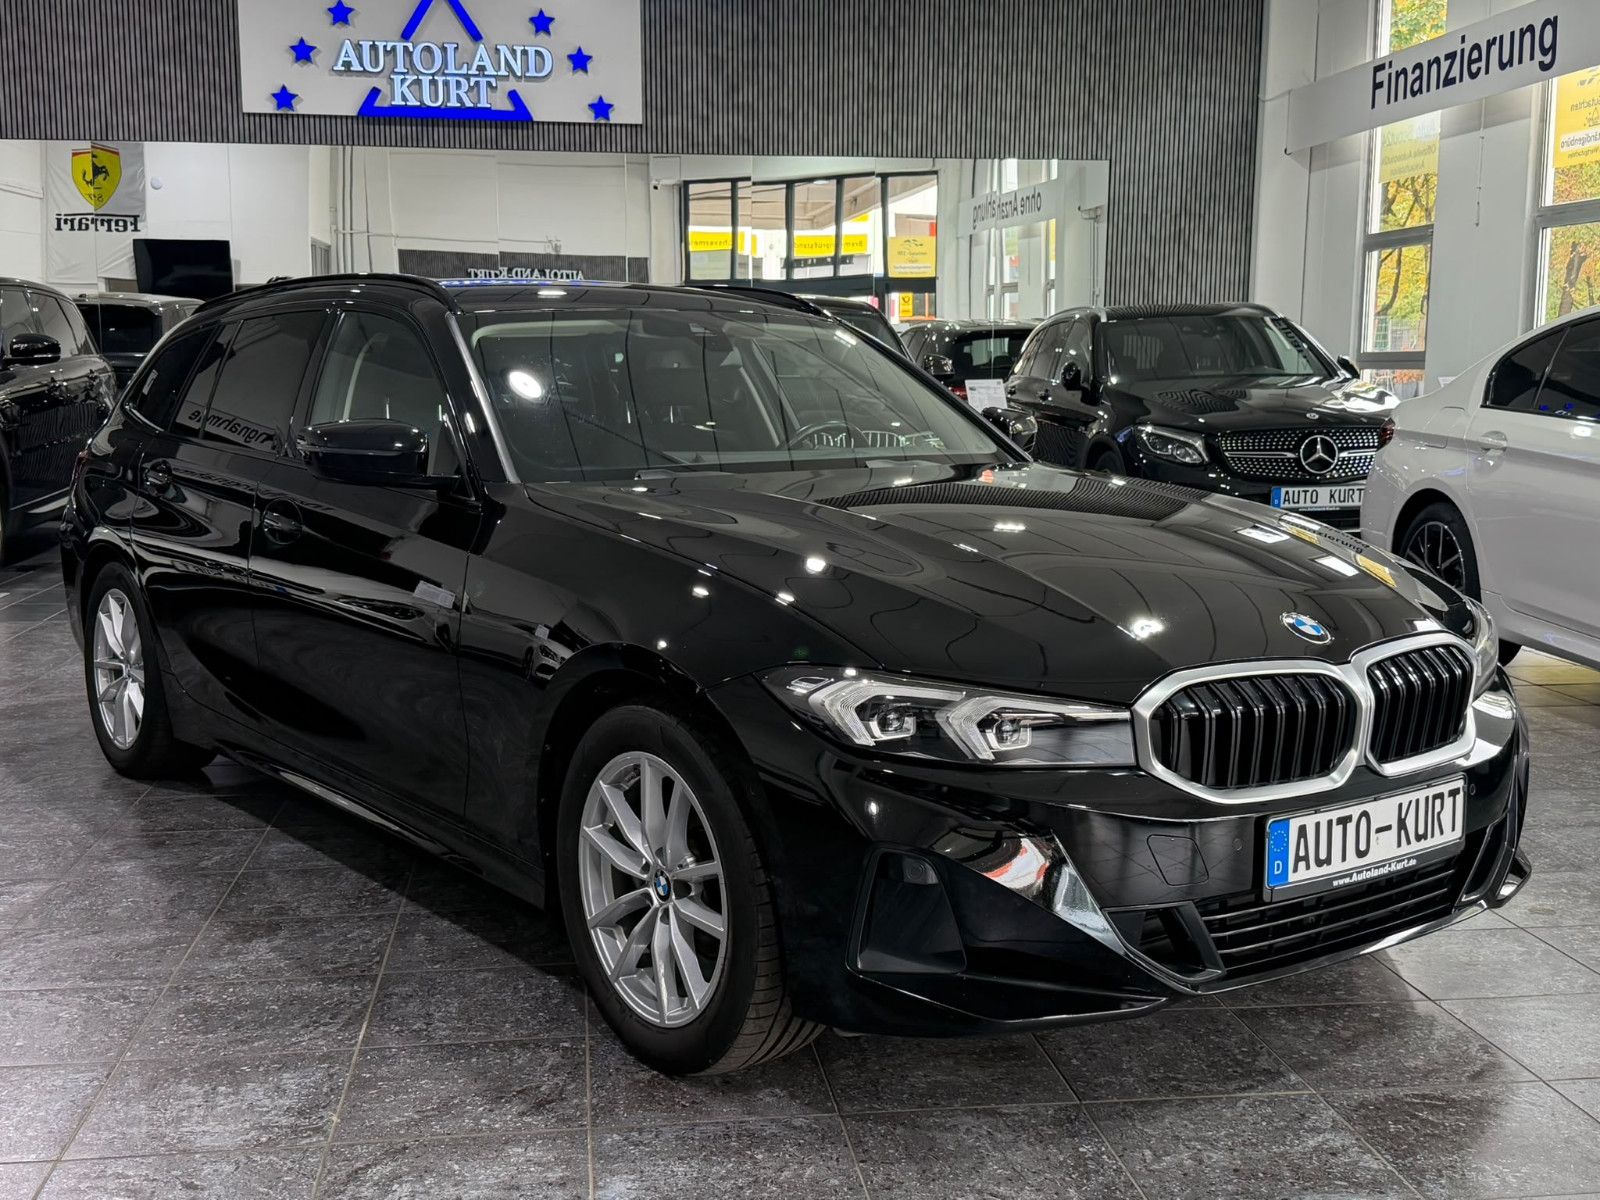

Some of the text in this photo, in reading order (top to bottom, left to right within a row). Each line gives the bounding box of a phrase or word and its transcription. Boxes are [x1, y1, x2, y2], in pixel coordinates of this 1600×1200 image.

[332, 39, 553, 78] AUTOLAND
[1371, 15, 1558, 110] Finanzierung
[389, 74, 497, 108] KURT
[1282, 488, 1365, 505] AUTO KURT
[1292, 787, 1462, 874] AUTO-KURT
[1274, 860, 1283, 875] D
[1332, 858, 1417, 887] www.Autoland-Kurt.de
